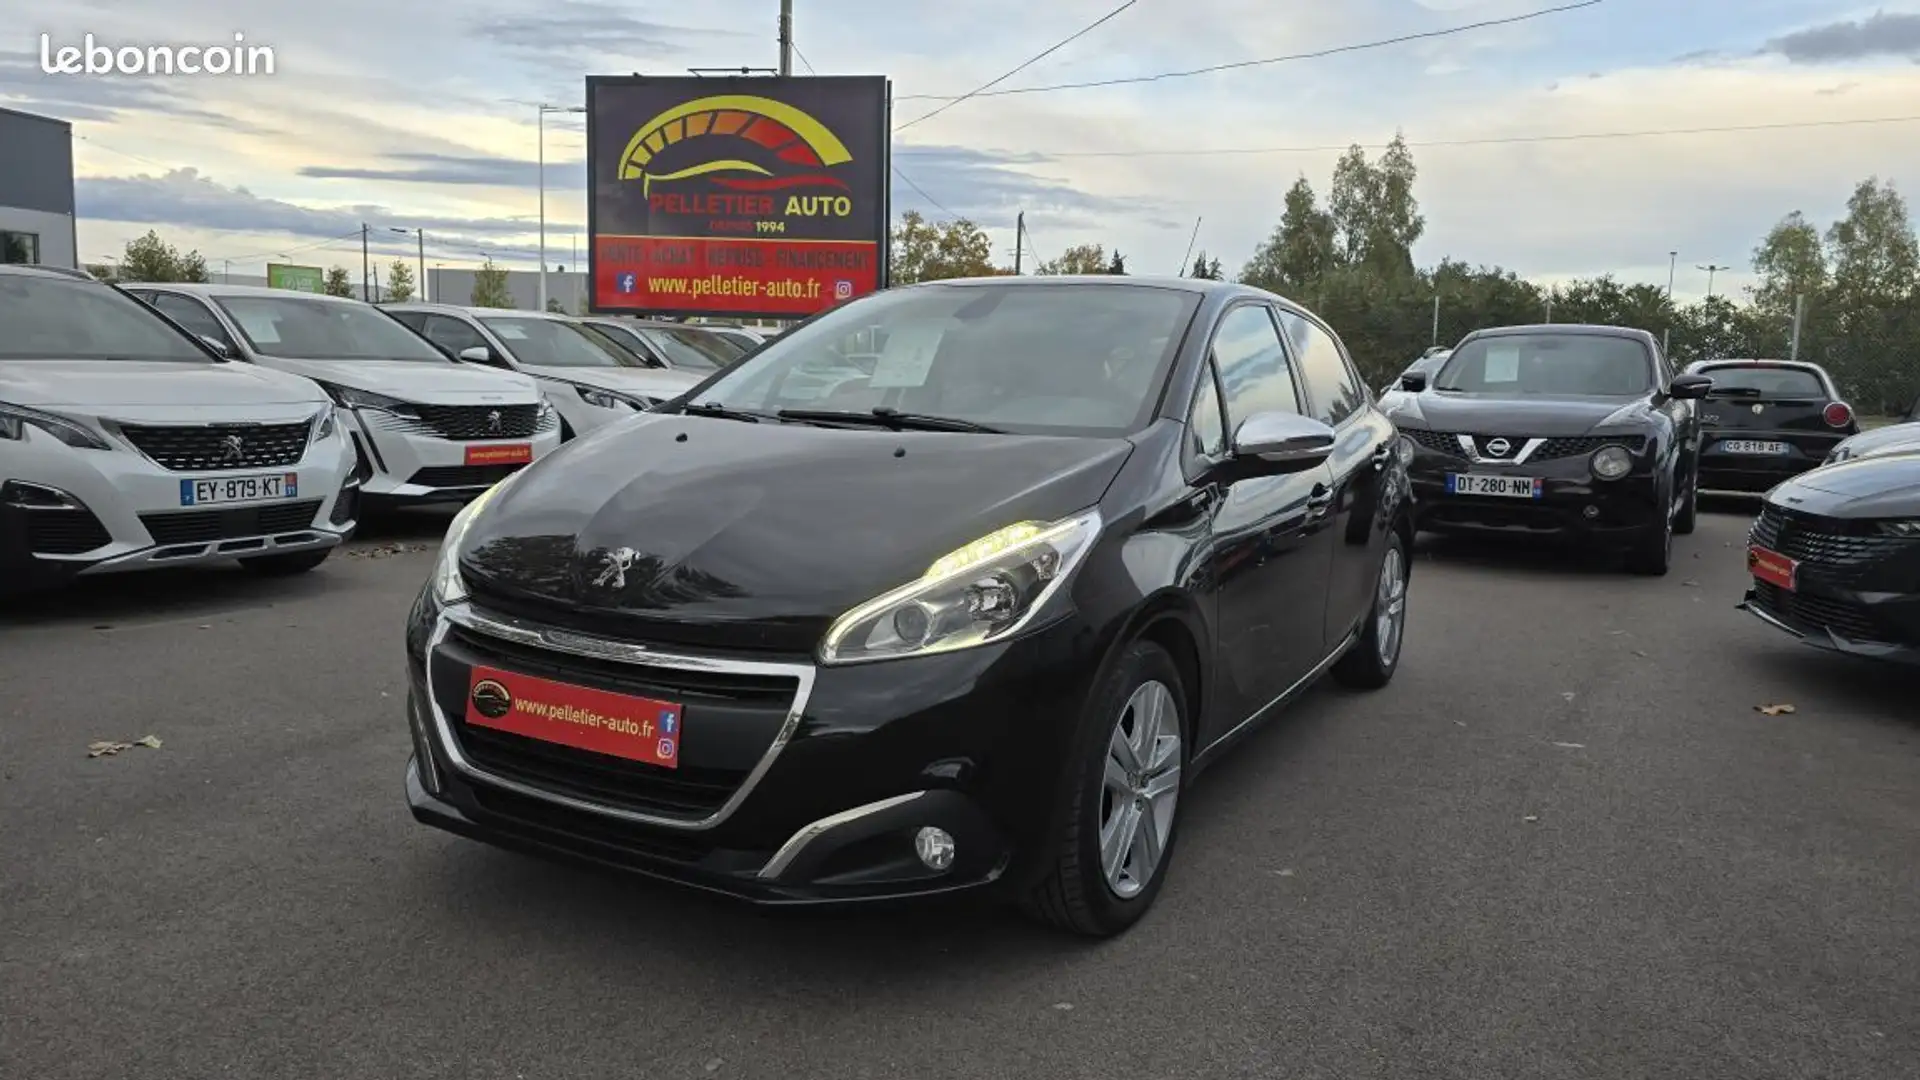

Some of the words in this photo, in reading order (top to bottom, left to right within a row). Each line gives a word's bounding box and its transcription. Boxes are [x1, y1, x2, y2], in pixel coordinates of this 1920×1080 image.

[648, 192, 775, 216] PELLETIER
[784, 195, 852, 217] AUTO
[755, 221, 786, 234] 1994
[775, 248, 870, 271] FINANCEMENT
[648, 273, 821, 300] www.pelletier-auto.fr
[514, 696, 655, 738] www.pelletier-auto.fr
